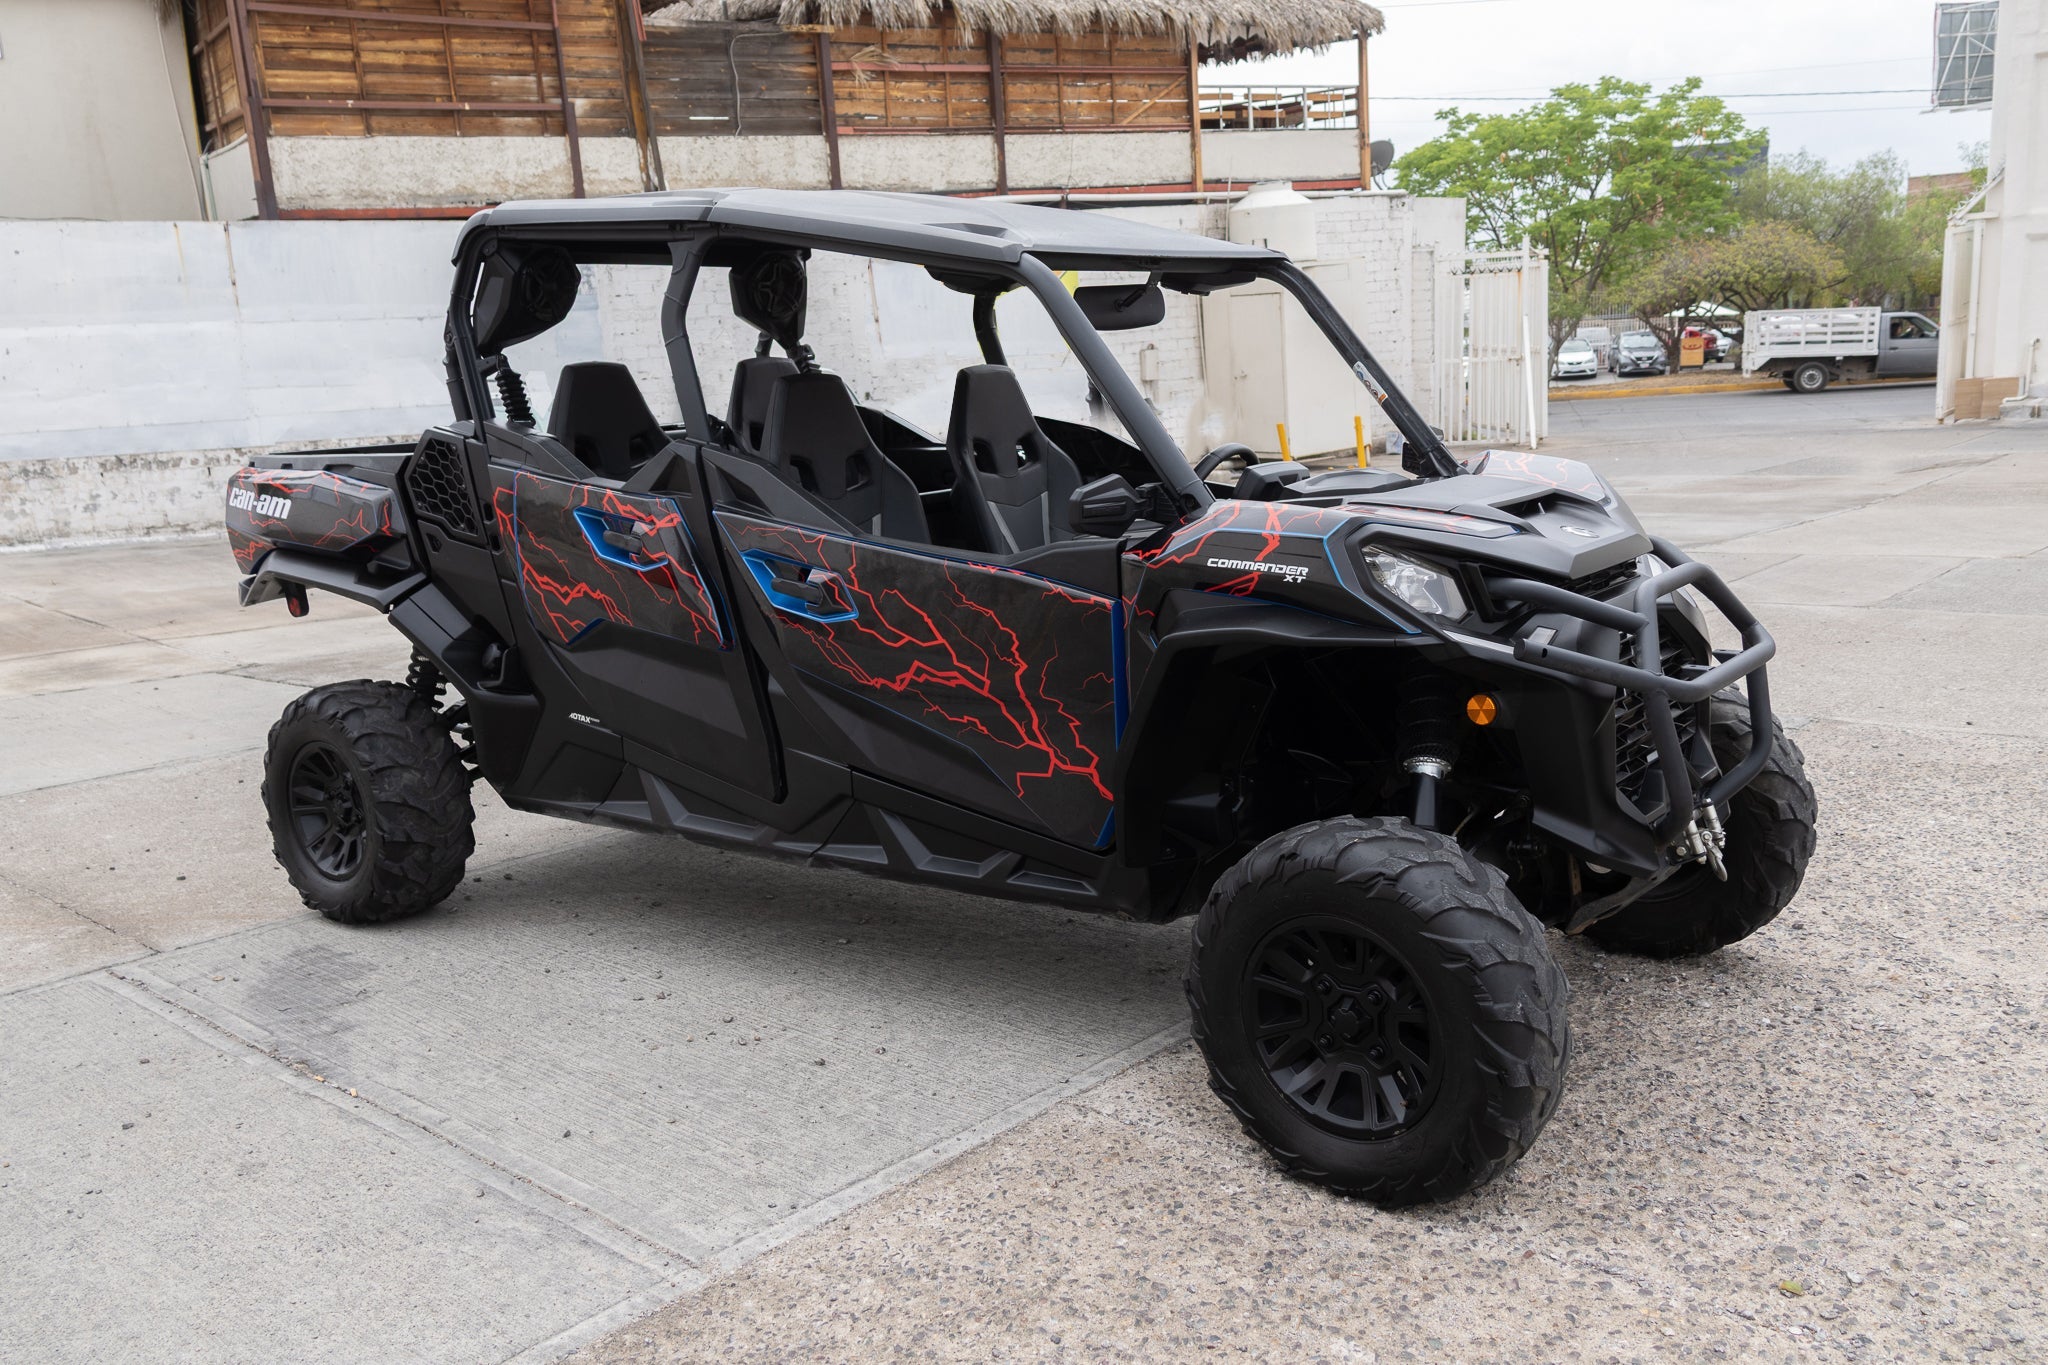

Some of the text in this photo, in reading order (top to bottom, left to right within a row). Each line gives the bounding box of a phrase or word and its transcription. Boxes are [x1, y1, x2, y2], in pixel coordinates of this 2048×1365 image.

[229, 487, 292, 519] can-am
[1208, 558, 1309, 576] COMMANDER
[1283, 574, 1306, 583] XT
